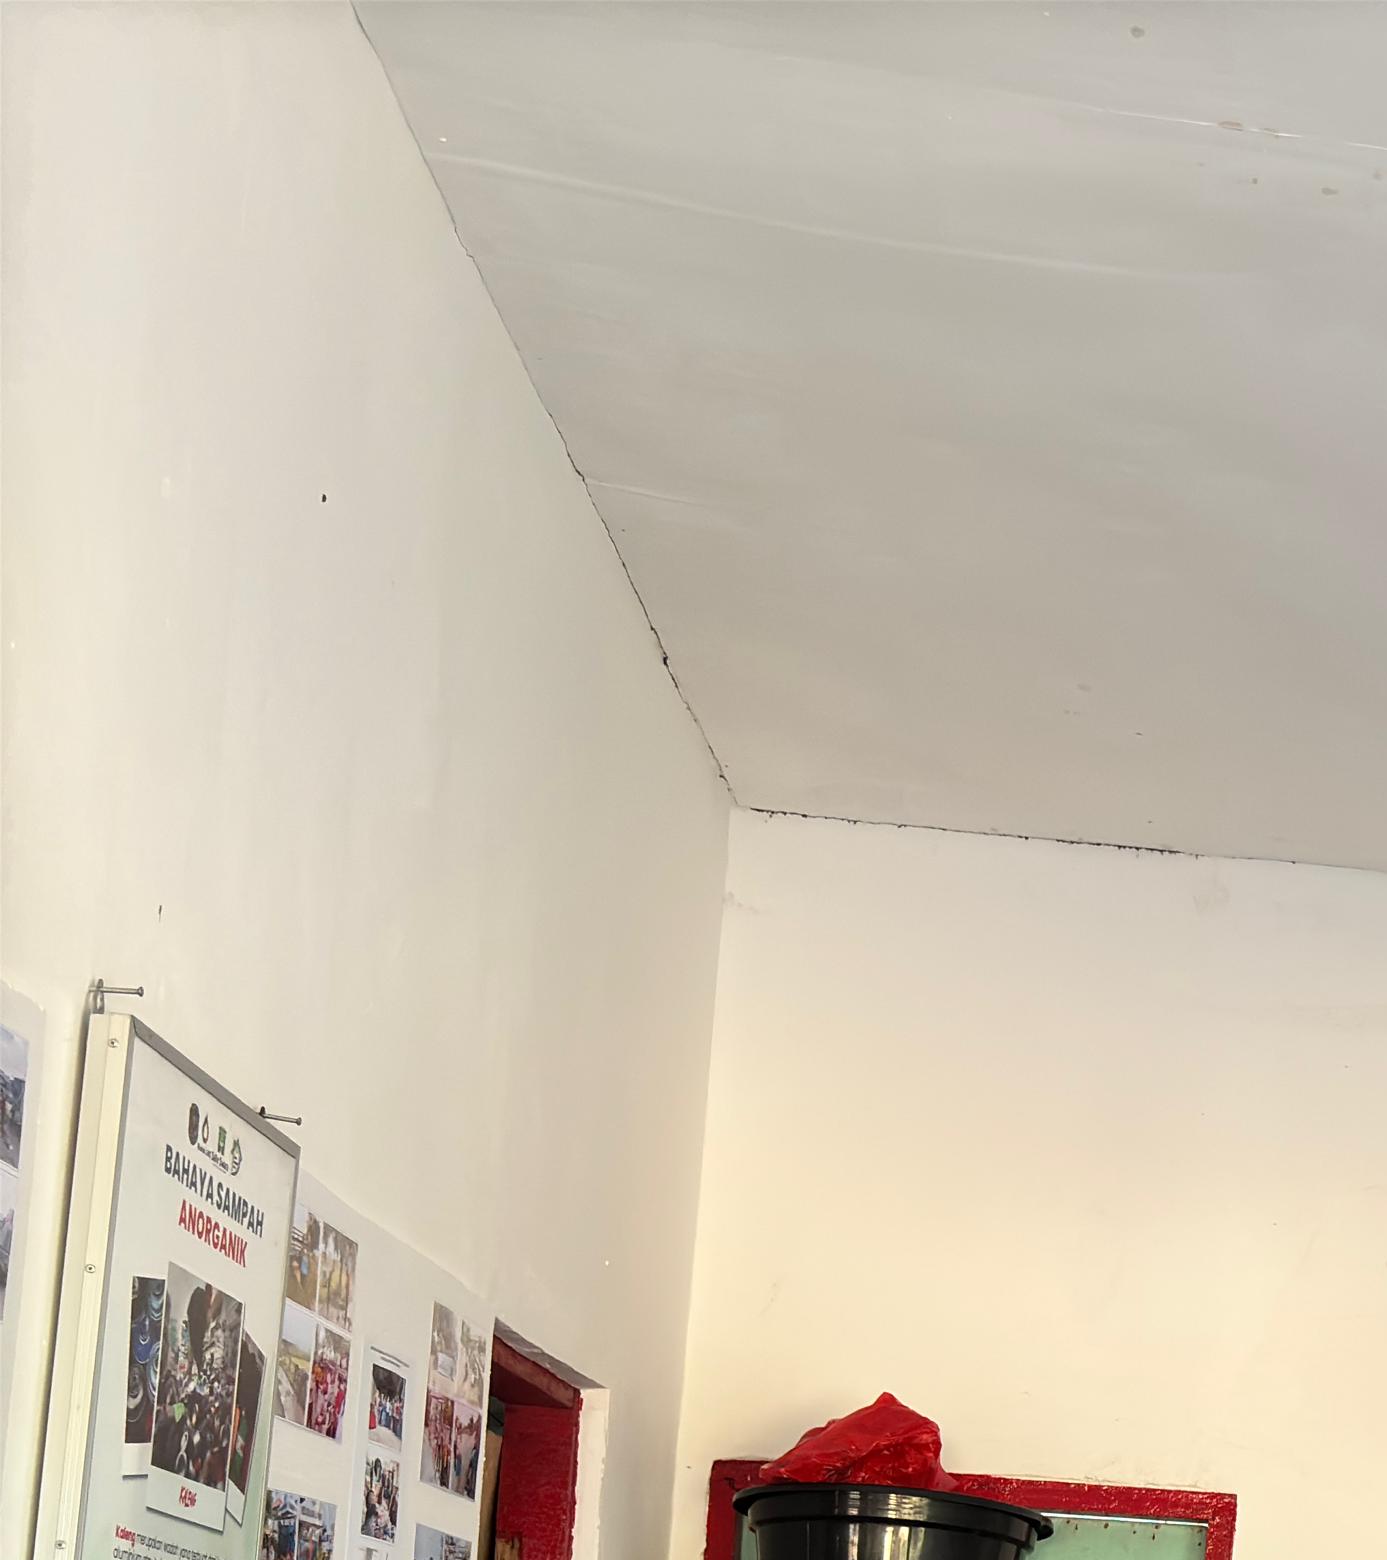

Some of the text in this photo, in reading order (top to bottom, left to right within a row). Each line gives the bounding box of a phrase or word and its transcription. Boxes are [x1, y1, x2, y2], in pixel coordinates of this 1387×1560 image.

[165, 1144, 214, 1205] BAHAYA
[216, 1182, 264, 1238] SAMPAH
[178, 1200, 248, 1267] ANORGANIK
